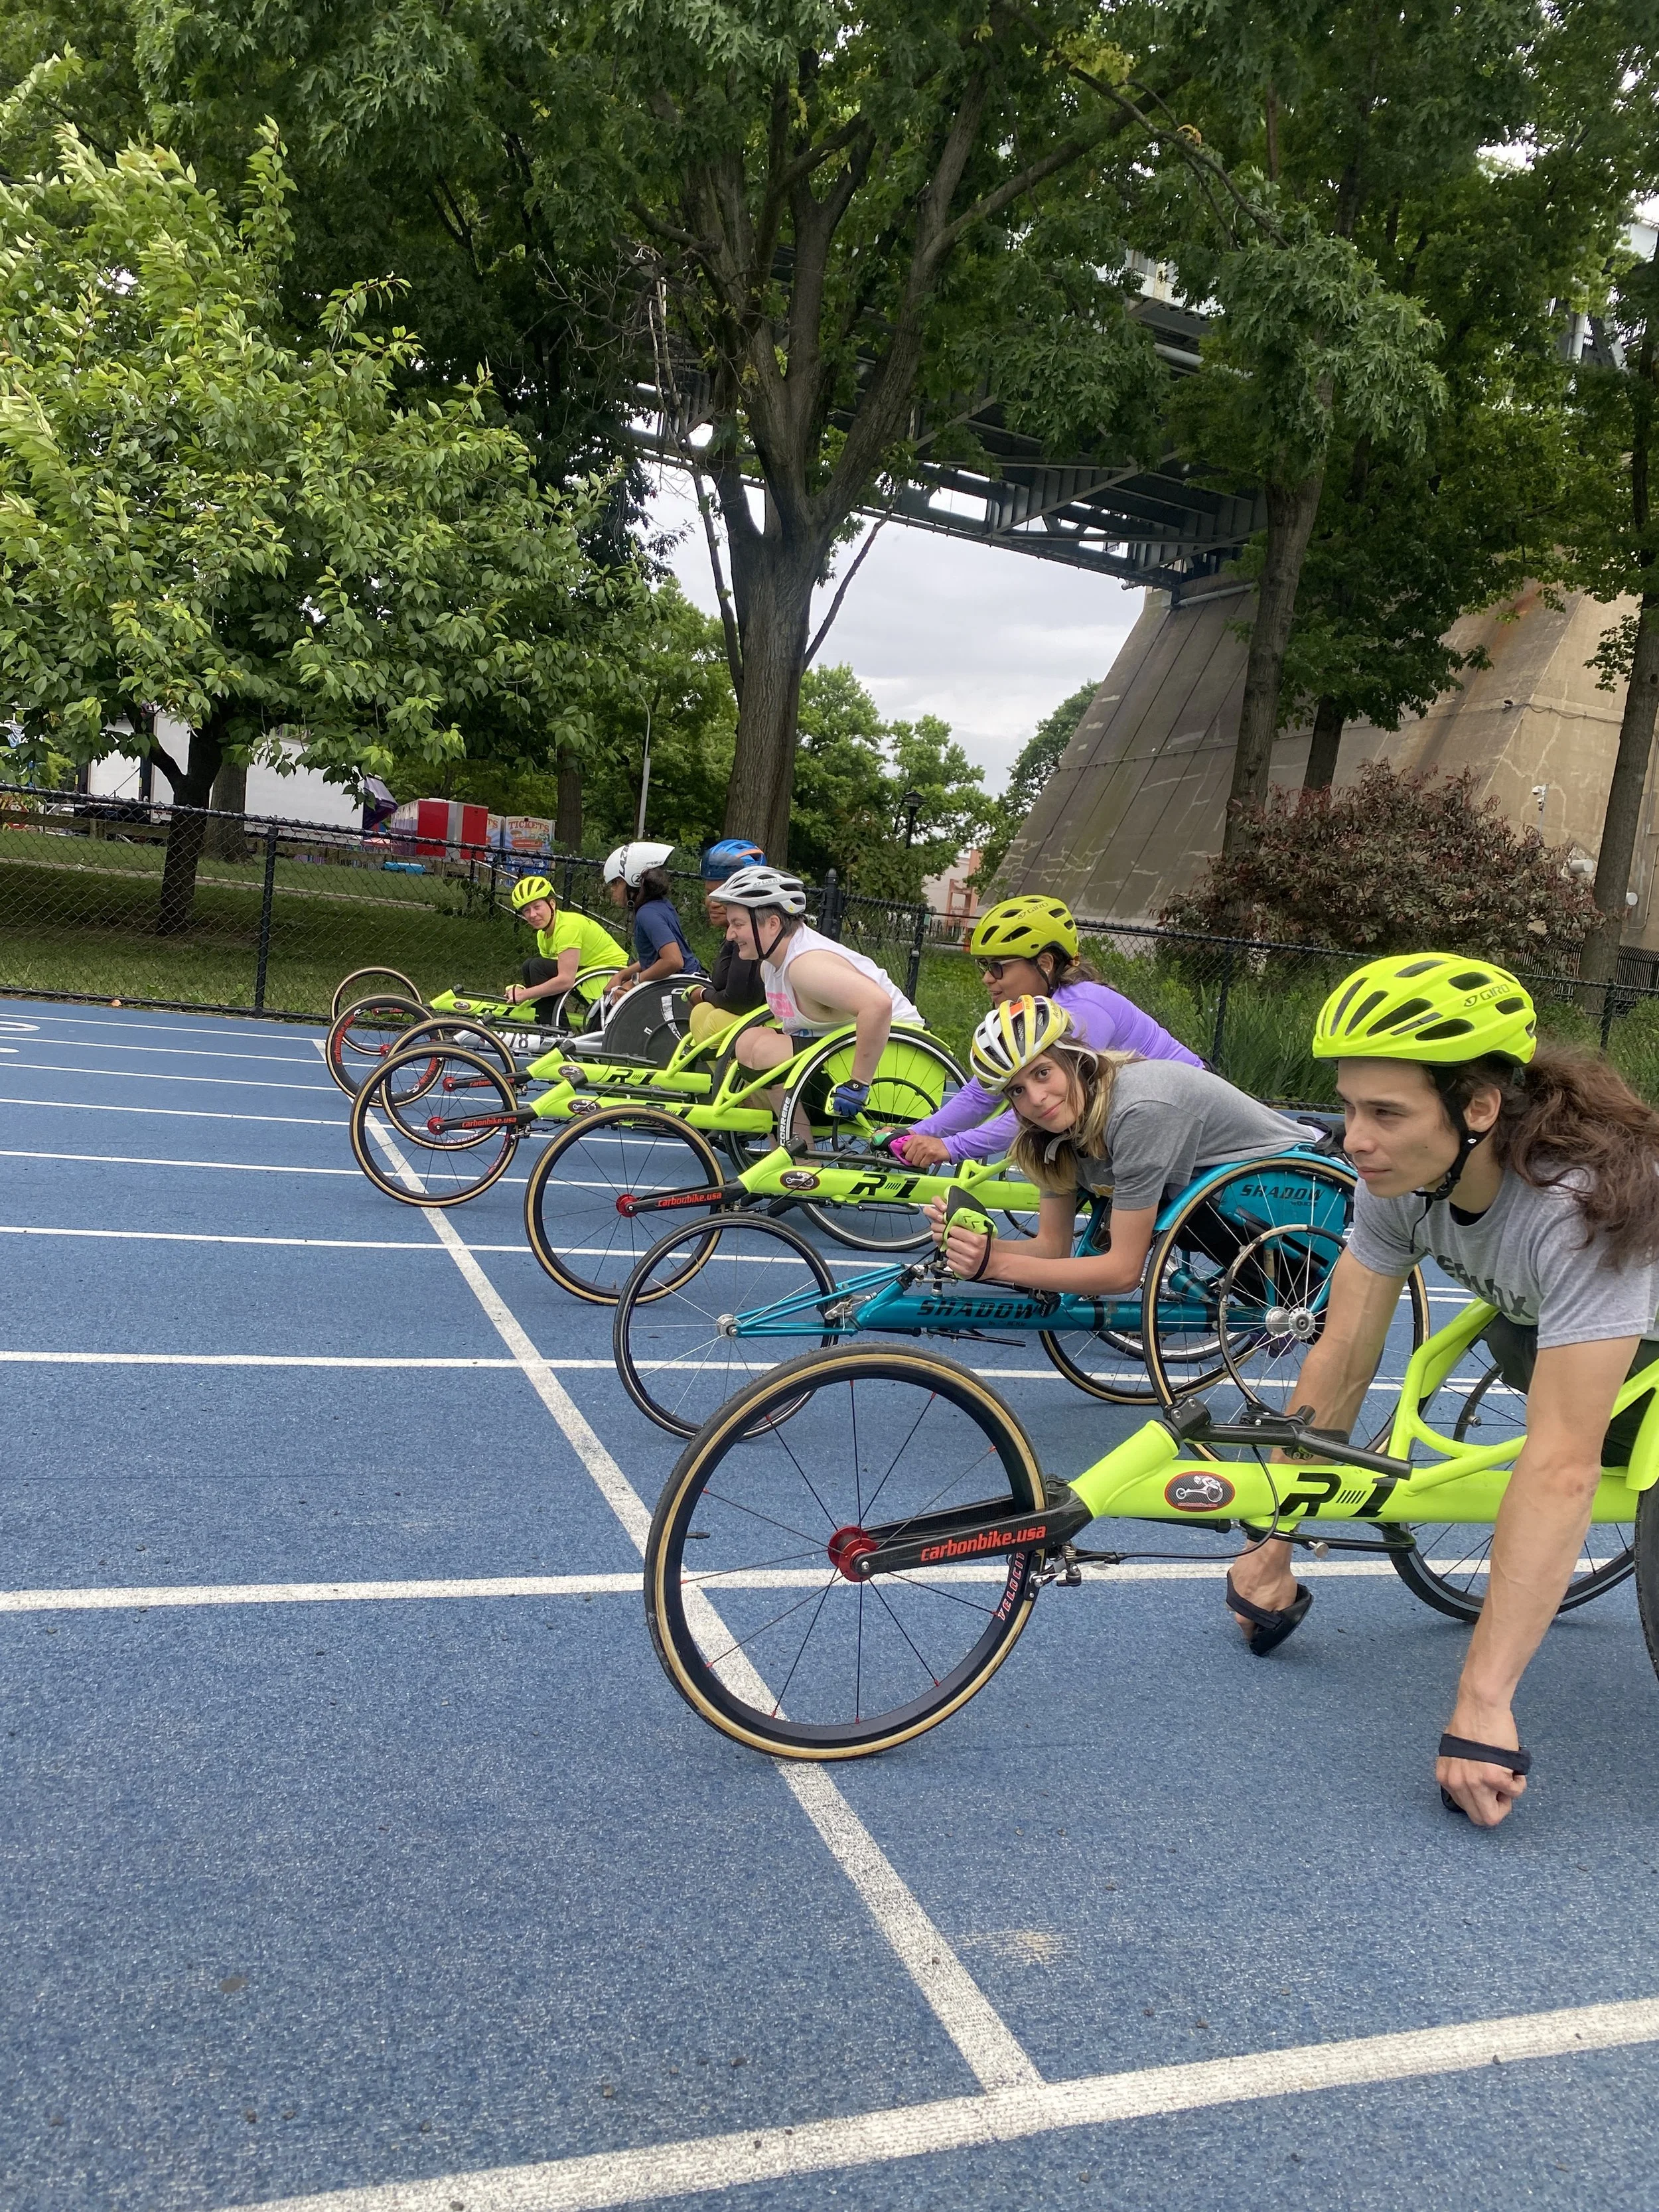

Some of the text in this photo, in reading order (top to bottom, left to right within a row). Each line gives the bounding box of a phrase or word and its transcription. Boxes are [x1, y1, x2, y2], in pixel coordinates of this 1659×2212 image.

[508, 821, 549, 833] TICKETS
[1027, 903, 1048, 913] GIRO
[1480, 984, 1510, 1001] GIRO
[461, 1117, 517, 1128] carbonbike.usa
[780, 1096, 791, 1146] CORRERE
[658, 1192, 722, 1207] carbonbike.usa
[1240, 1184, 1326, 1201] SHADOW
[916, 1299, 1040, 1319] SHADOW
[920, 1525, 1046, 1562] carbonbike.usa
[997, 1551, 1025, 1621] VELOCIT
